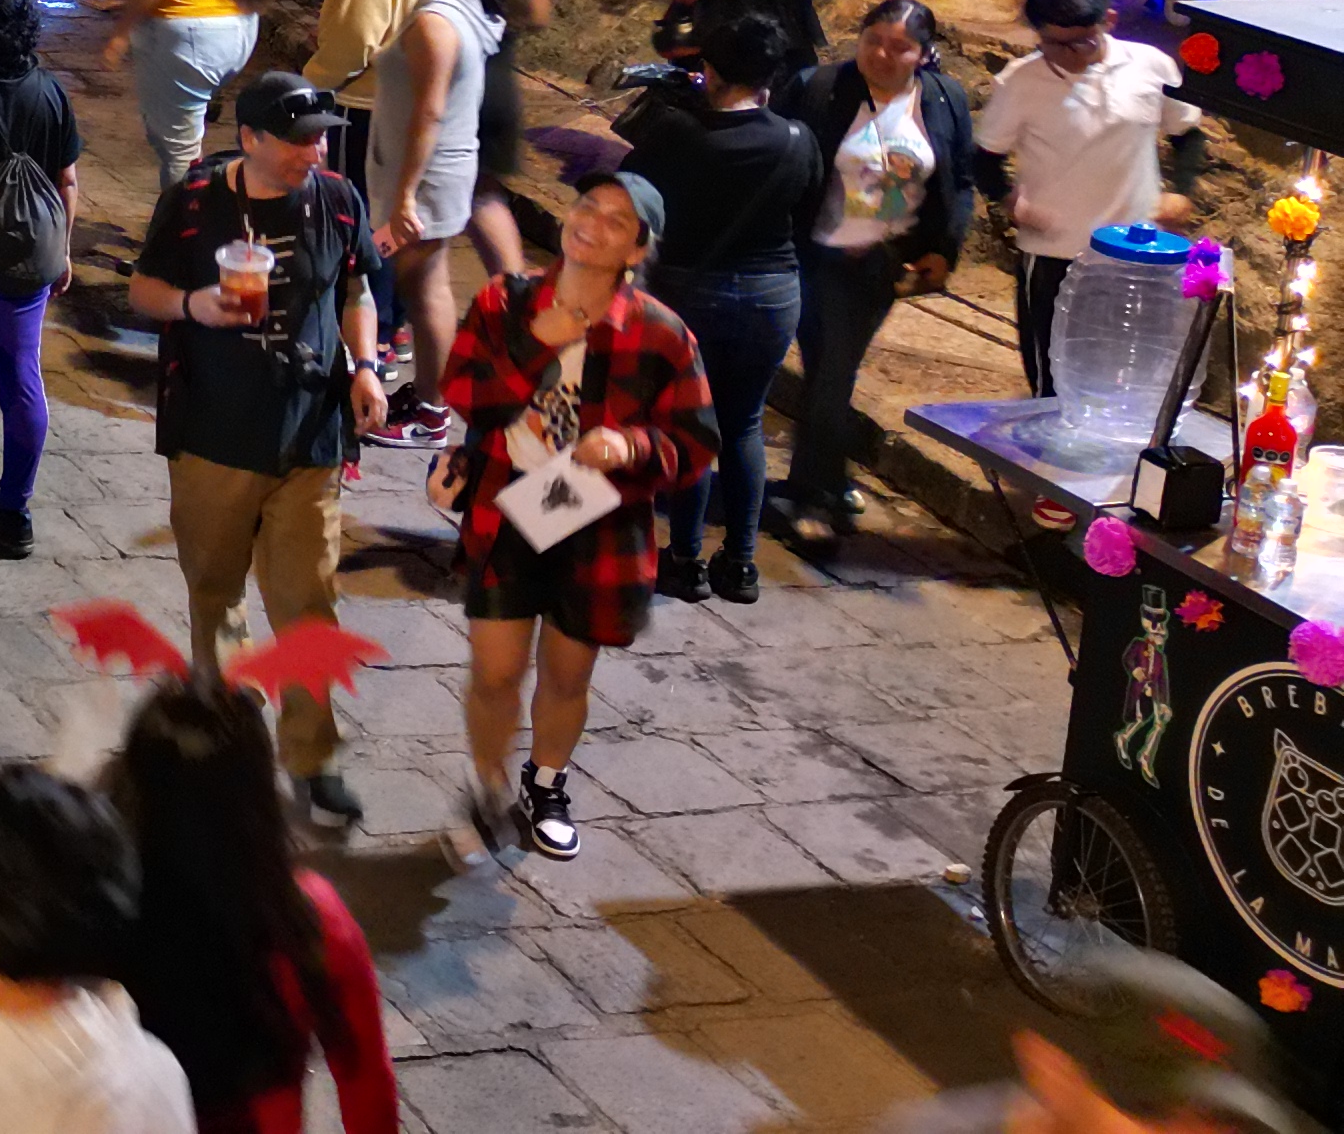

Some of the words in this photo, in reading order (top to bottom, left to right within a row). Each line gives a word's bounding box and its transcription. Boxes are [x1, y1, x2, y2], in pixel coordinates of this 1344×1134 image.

[1237, 684, 1344, 729] BREB
[1208, 786, 1229, 829] DE
[1232, 868, 1265, 915] LA
